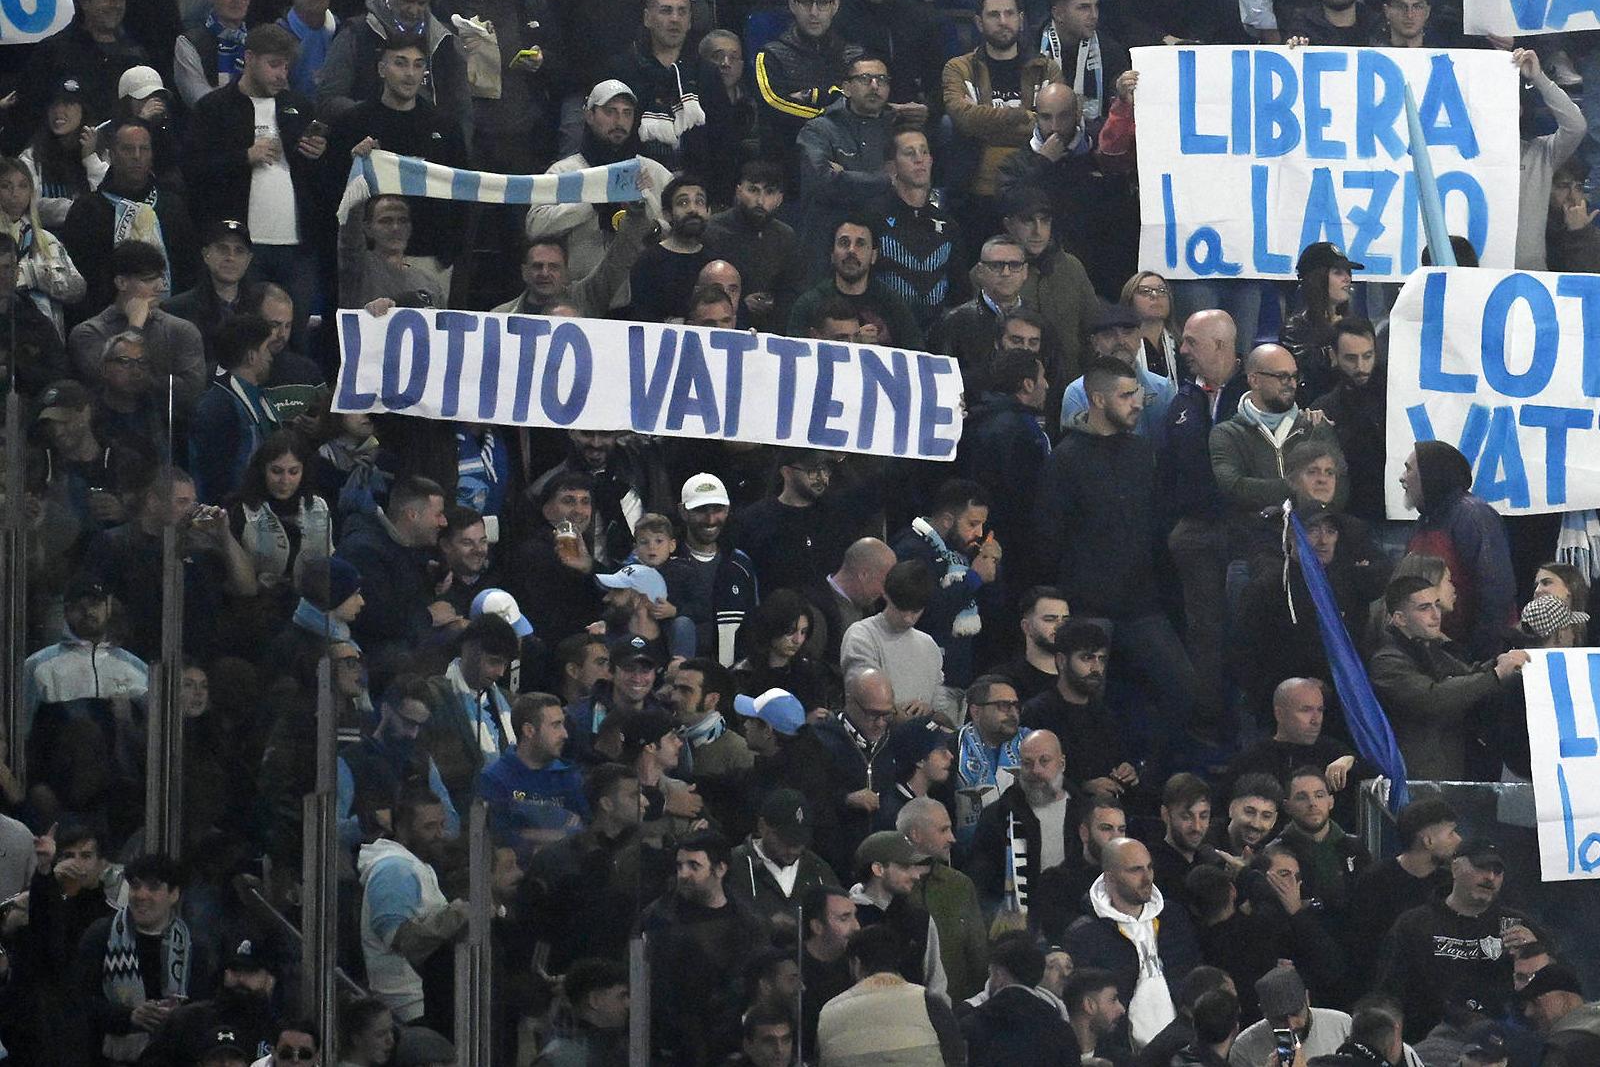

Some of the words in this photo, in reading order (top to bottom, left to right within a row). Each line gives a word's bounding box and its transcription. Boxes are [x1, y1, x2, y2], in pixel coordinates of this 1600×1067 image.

[1179, 50, 1479, 160] LIBERA
[1162, 174, 1241, 276] la
[1252, 165, 1488, 275] LAZIO
[338, 311, 591, 425] LOTITO
[629, 326, 951, 455] VATTENE
